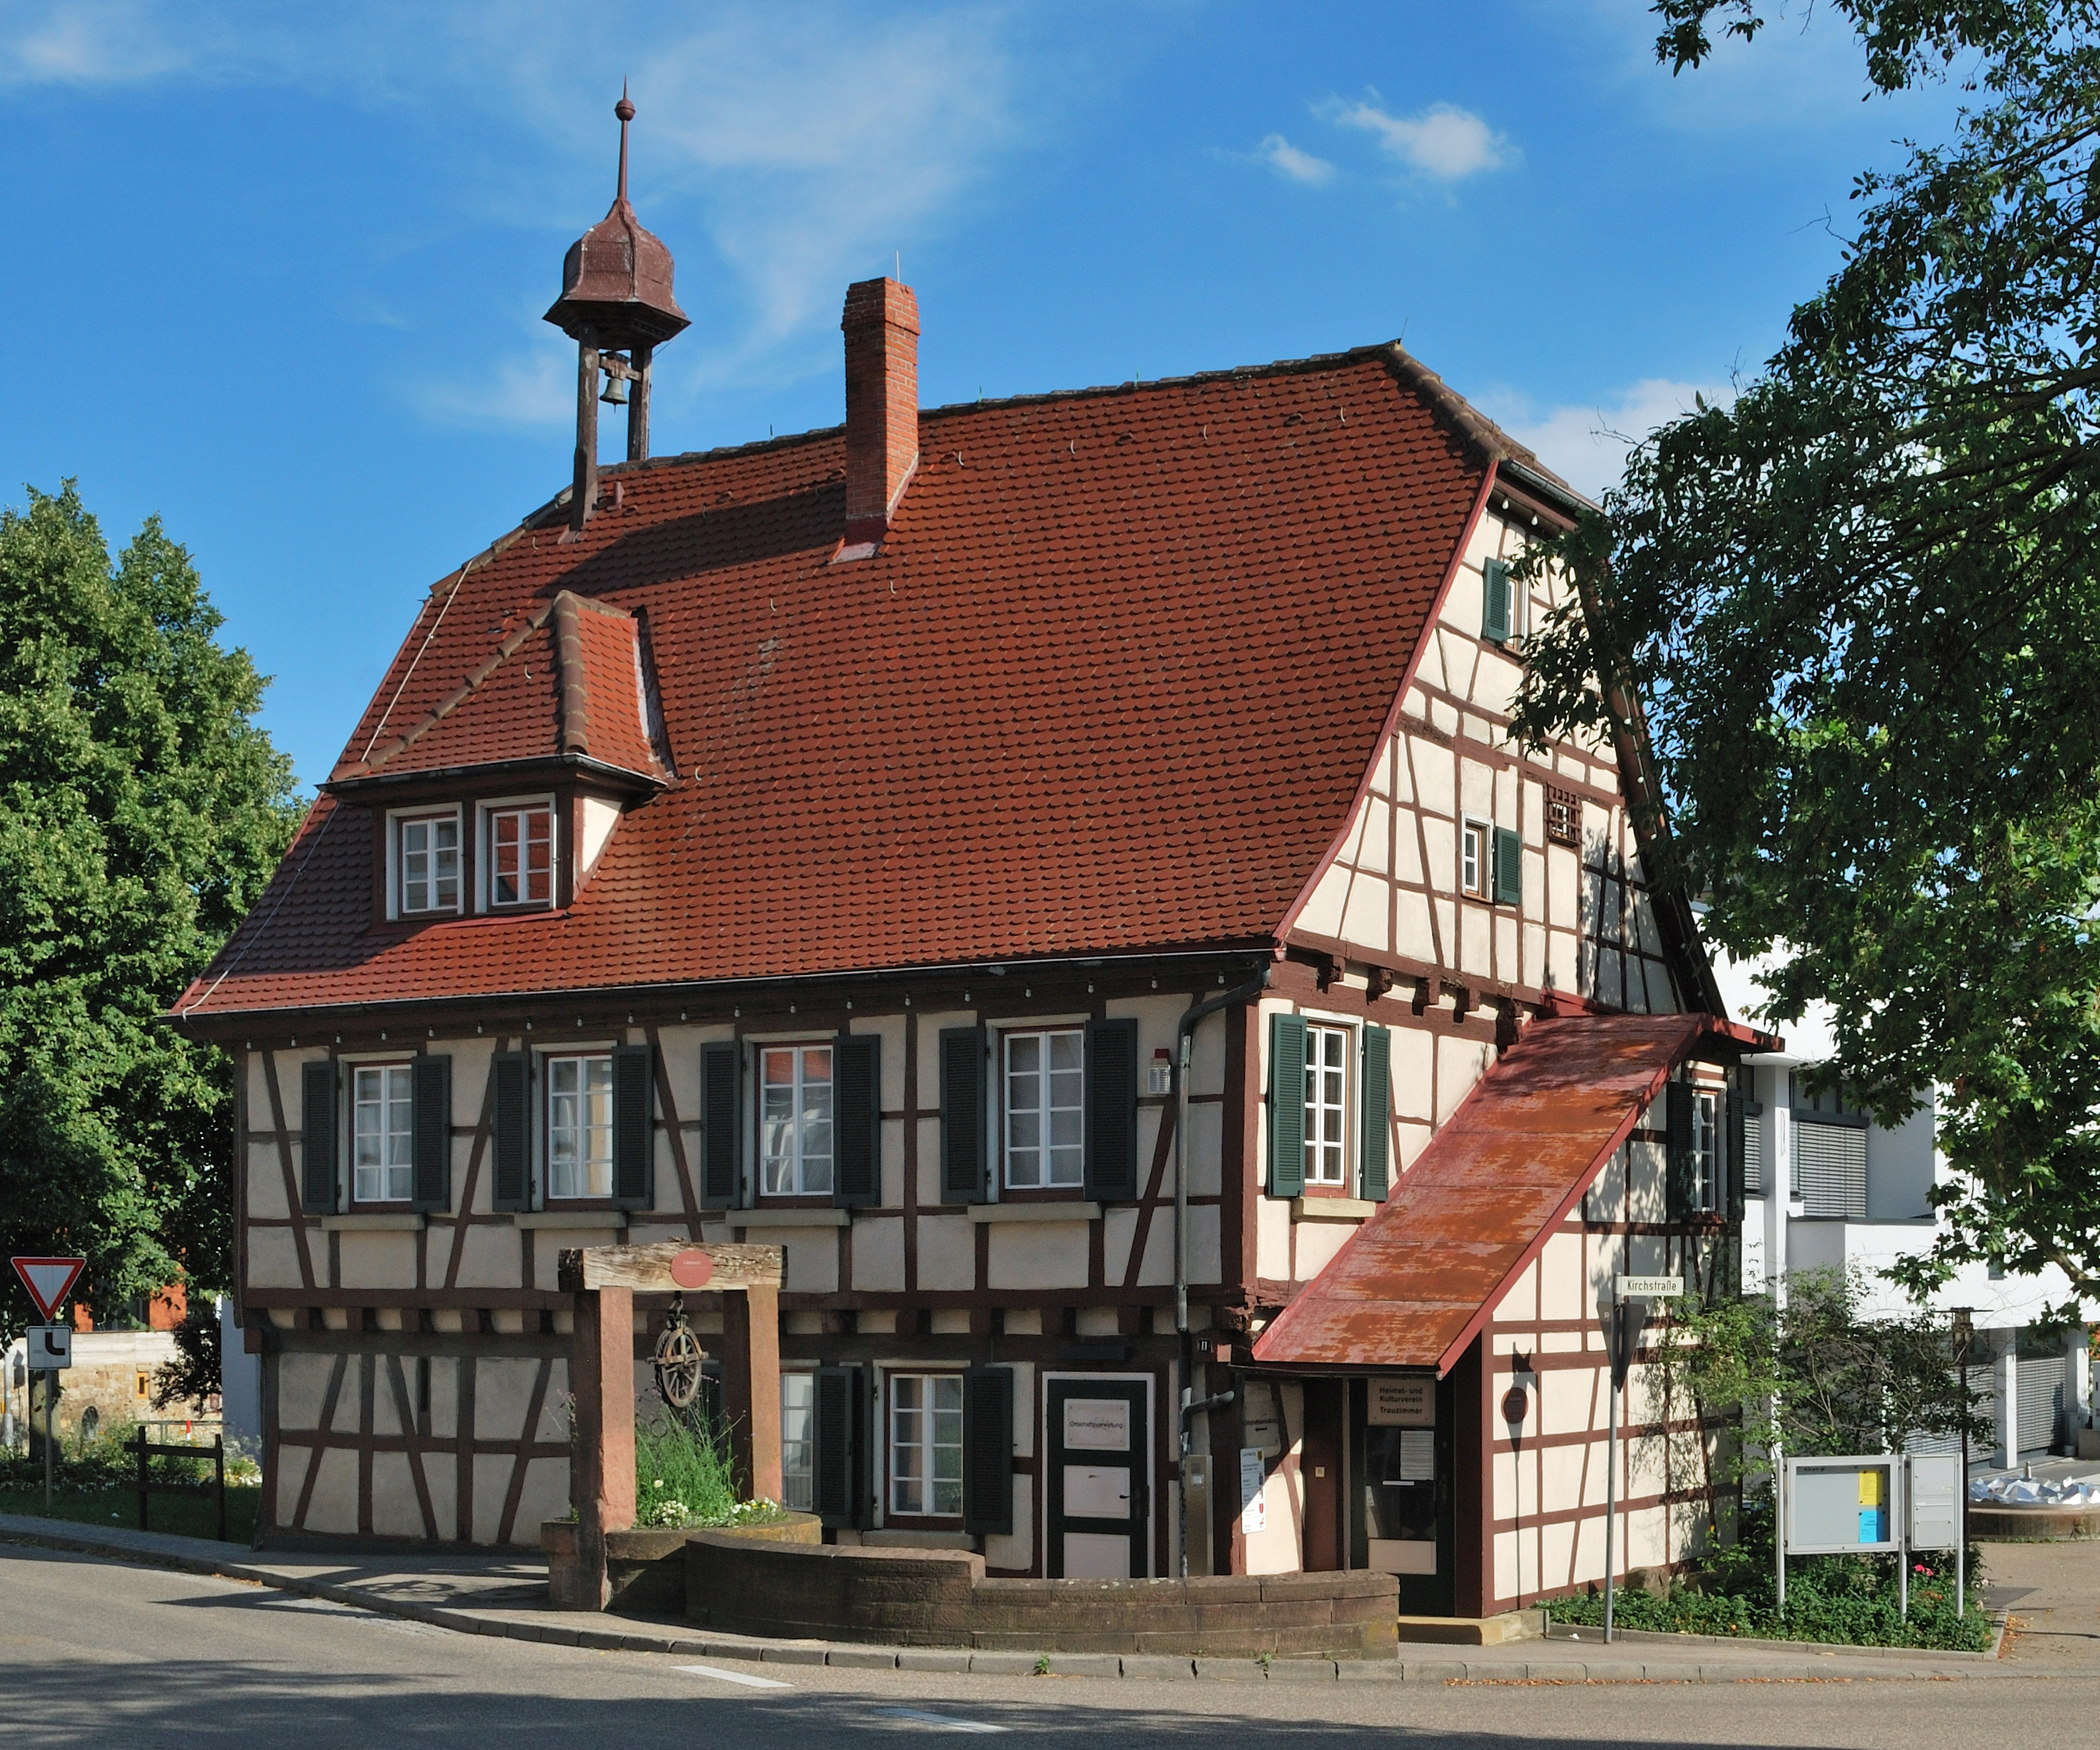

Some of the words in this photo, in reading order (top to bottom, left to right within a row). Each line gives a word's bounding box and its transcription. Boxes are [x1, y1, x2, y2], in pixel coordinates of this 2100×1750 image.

[1627, 1279, 1677, 1291] Kirchstraße
[1201, 1340, 1208, 1351] 11
[1380, 1406, 1422, 1414] Trauzimmer
